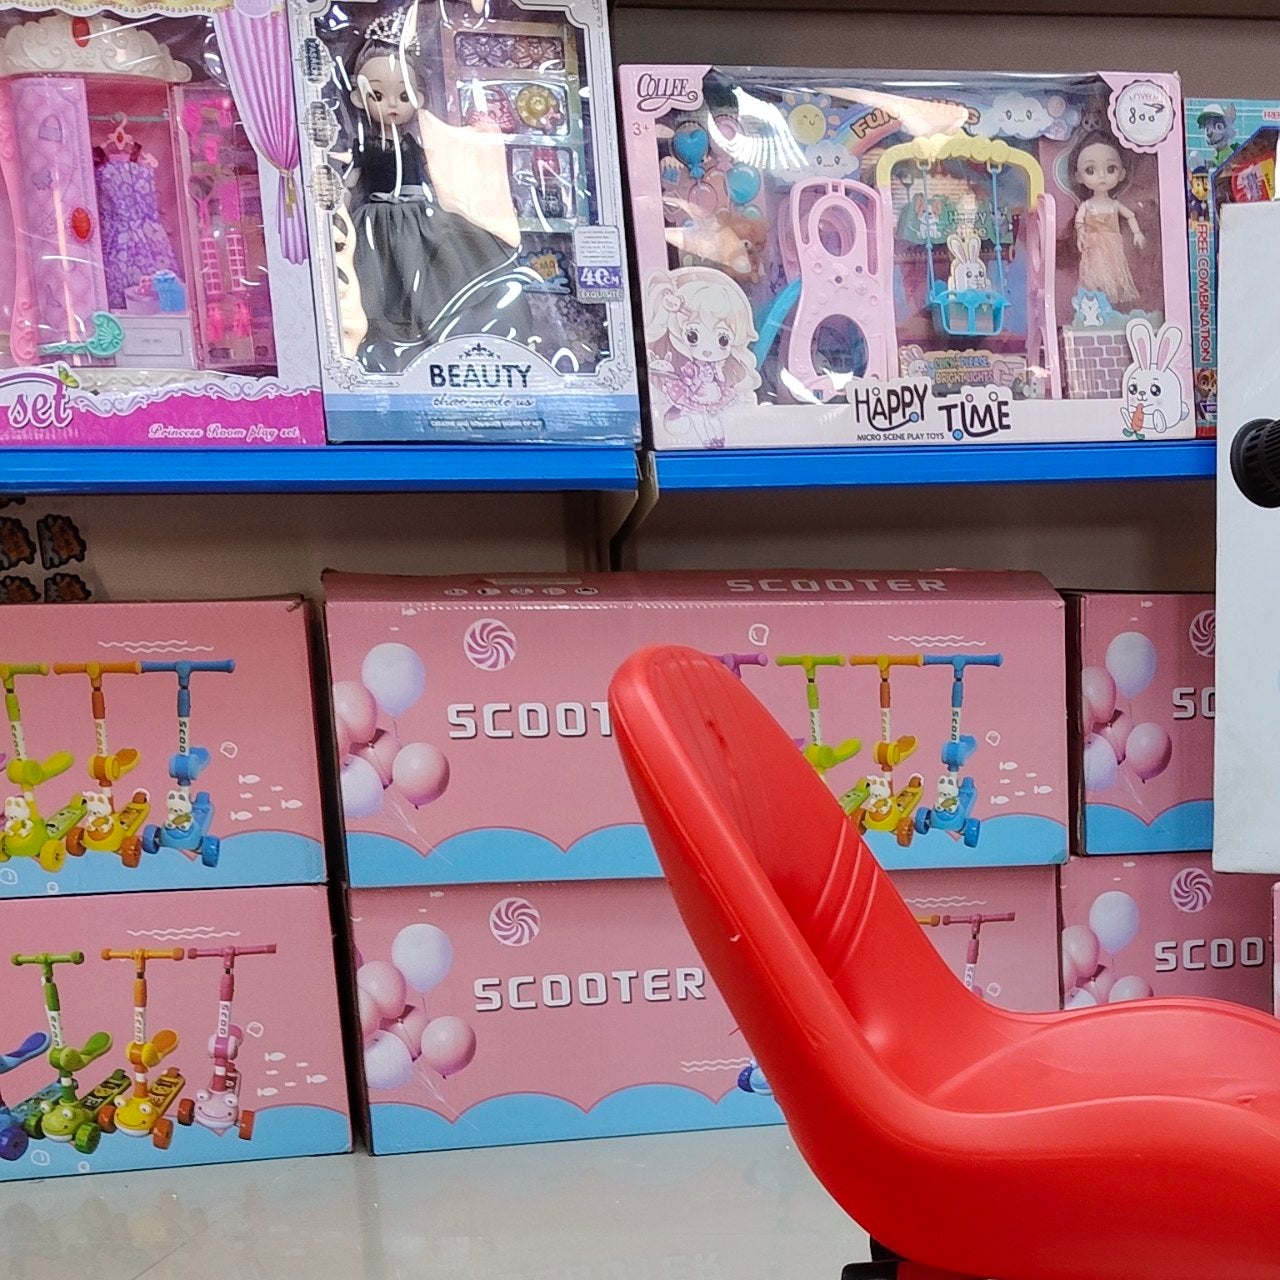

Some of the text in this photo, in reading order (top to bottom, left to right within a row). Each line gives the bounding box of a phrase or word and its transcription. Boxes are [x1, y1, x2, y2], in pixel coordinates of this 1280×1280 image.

[632, 121, 650, 136] 3+
[581, 290, 621, 299] EXQUISITE
[1196, 223, 1212, 362] FREE COMBINATION
[429, 364, 532, 389] BEAUTY
[9, 382, 72, 427] set
[854, 383, 1011, 439] HAPPY TIME
[149, 423, 300, 443] Princess Room play set
[857, 432, 945, 442] MICRO SCENE PLAY TOYS
[726, 579, 950, 593] SCOOTER
[178, 720, 187, 754] SCOO
[1154, 936, 1273, 972] SCOO
[474, 967, 706, 1012] SCOOTER
